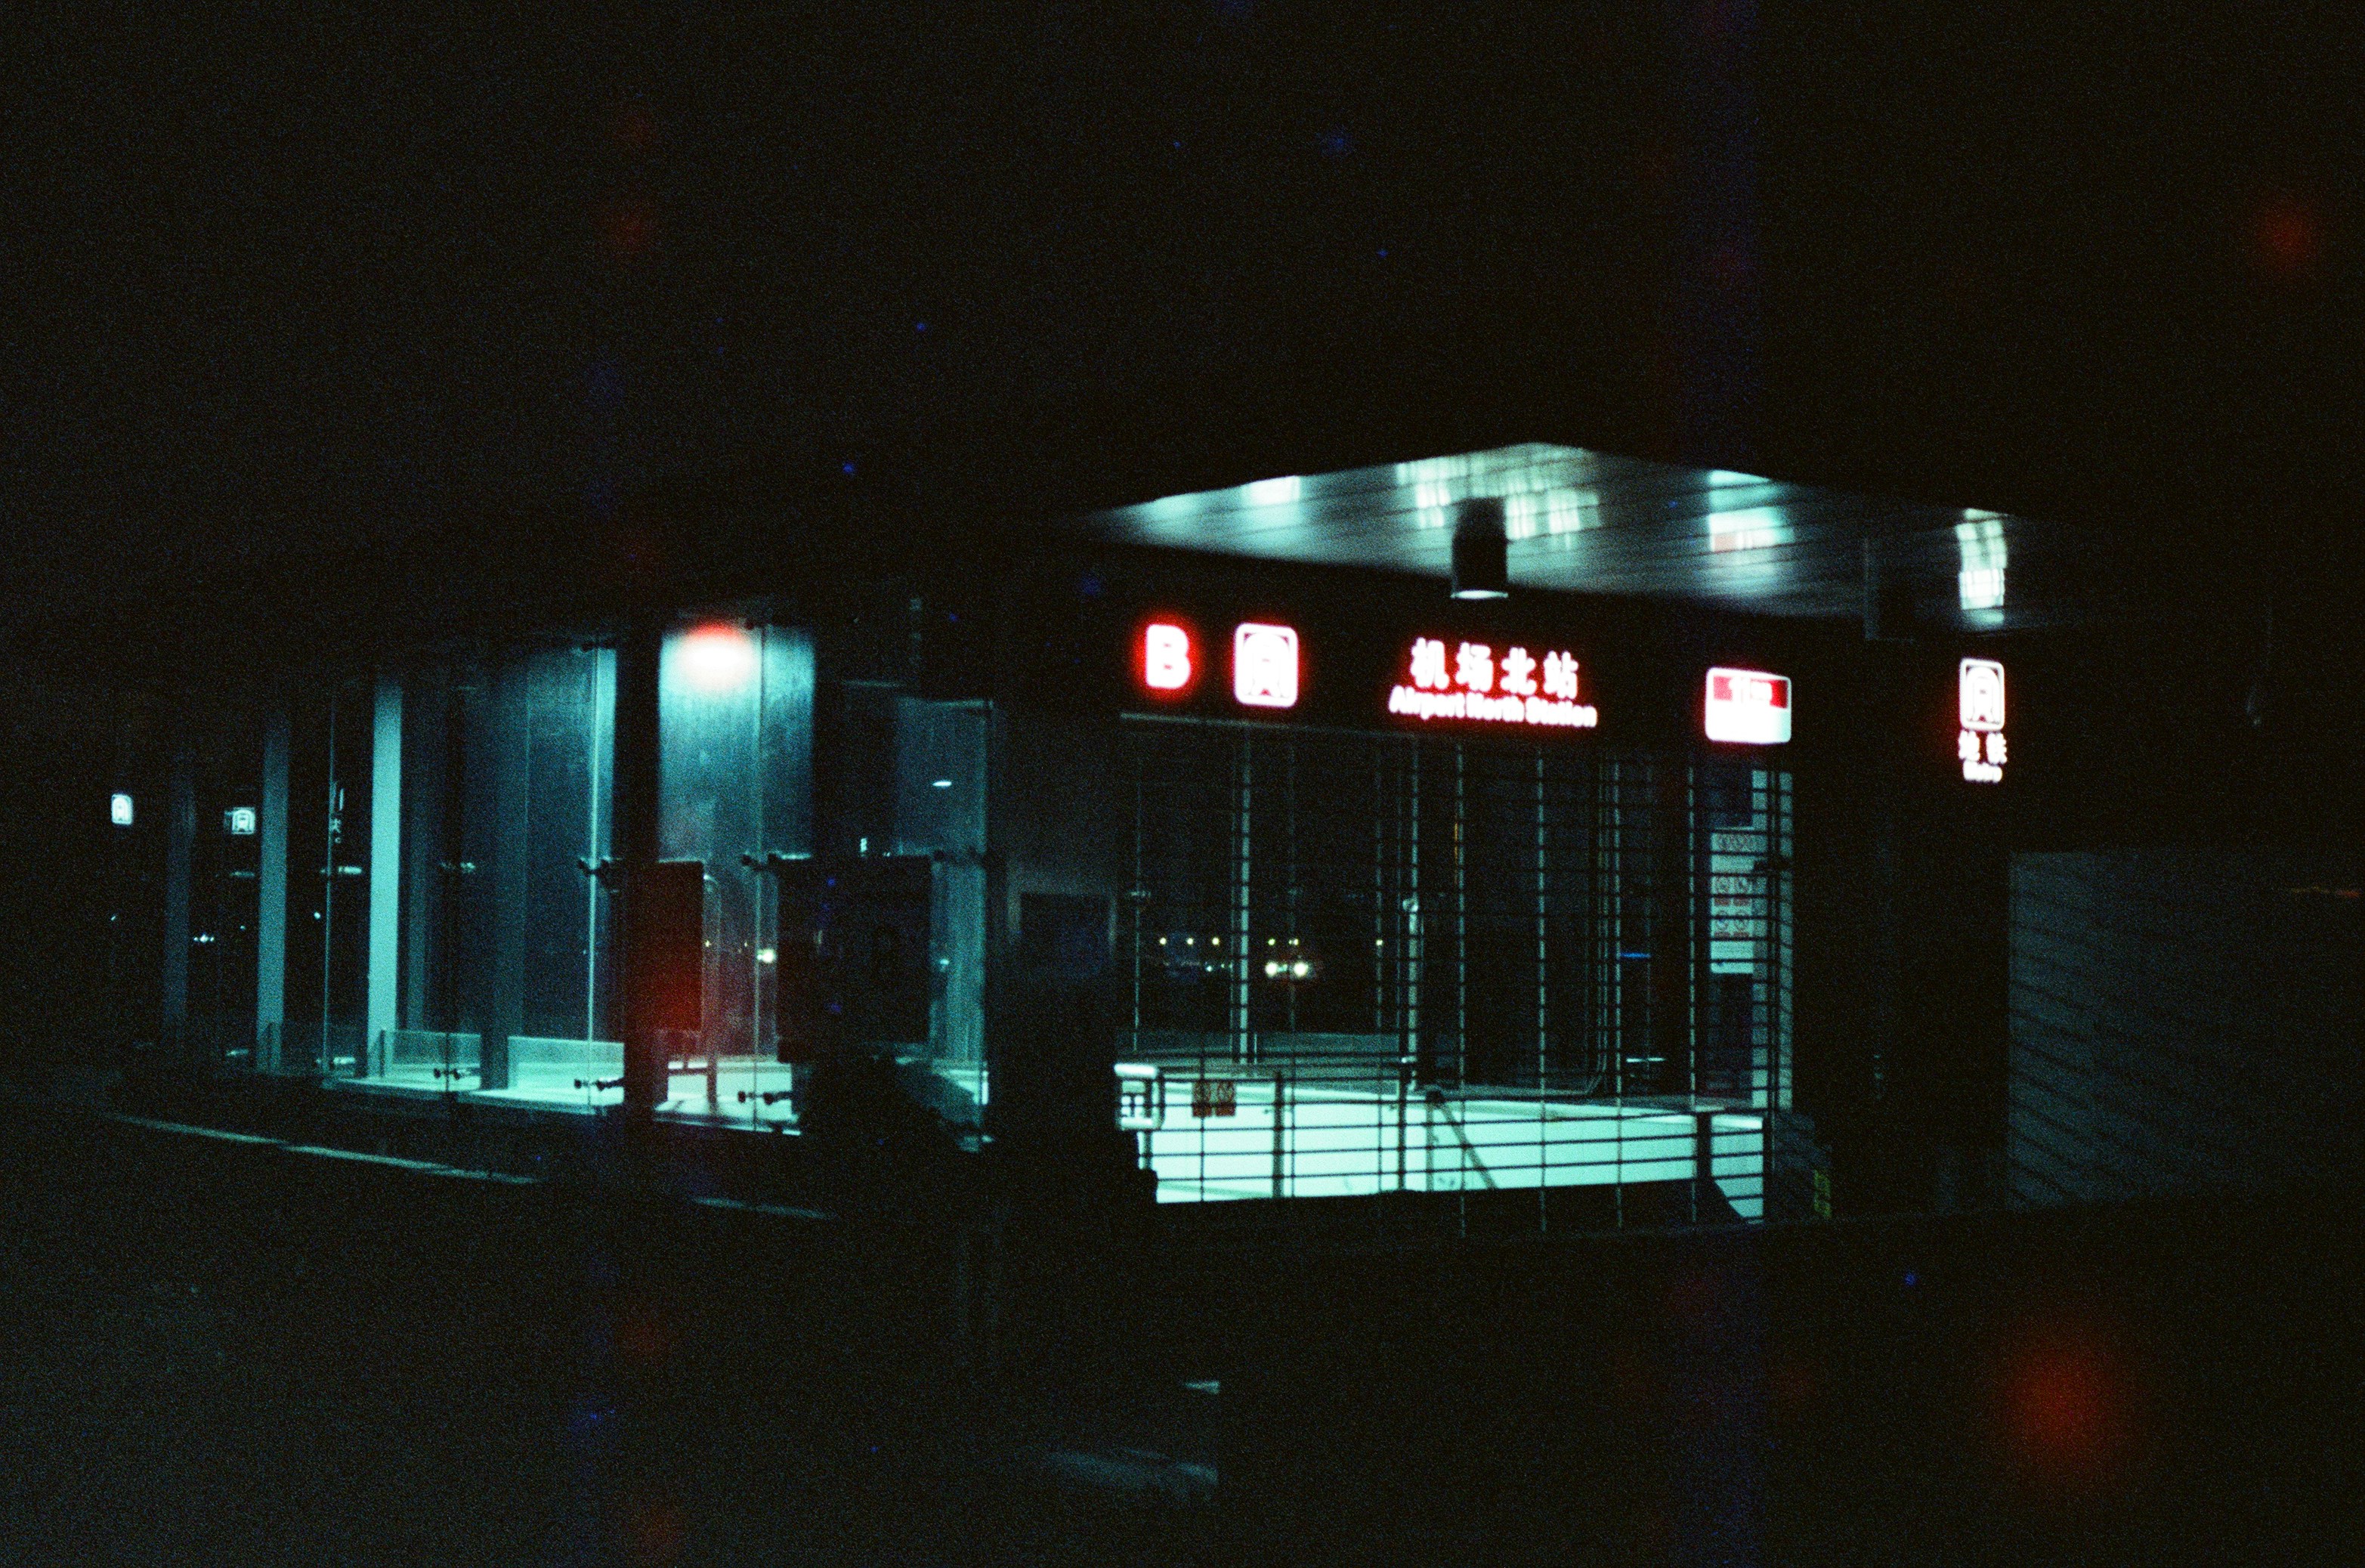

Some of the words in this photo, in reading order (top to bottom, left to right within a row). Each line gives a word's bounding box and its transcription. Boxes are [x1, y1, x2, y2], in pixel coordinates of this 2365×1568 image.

[1145, 623, 1192, 691] B
[1409, 637, 1579, 700] 机场北站
[1388, 684, 1465, 720] Airport
[1466, 691, 1525, 723] North
[1525, 696, 1598, 728] Station
